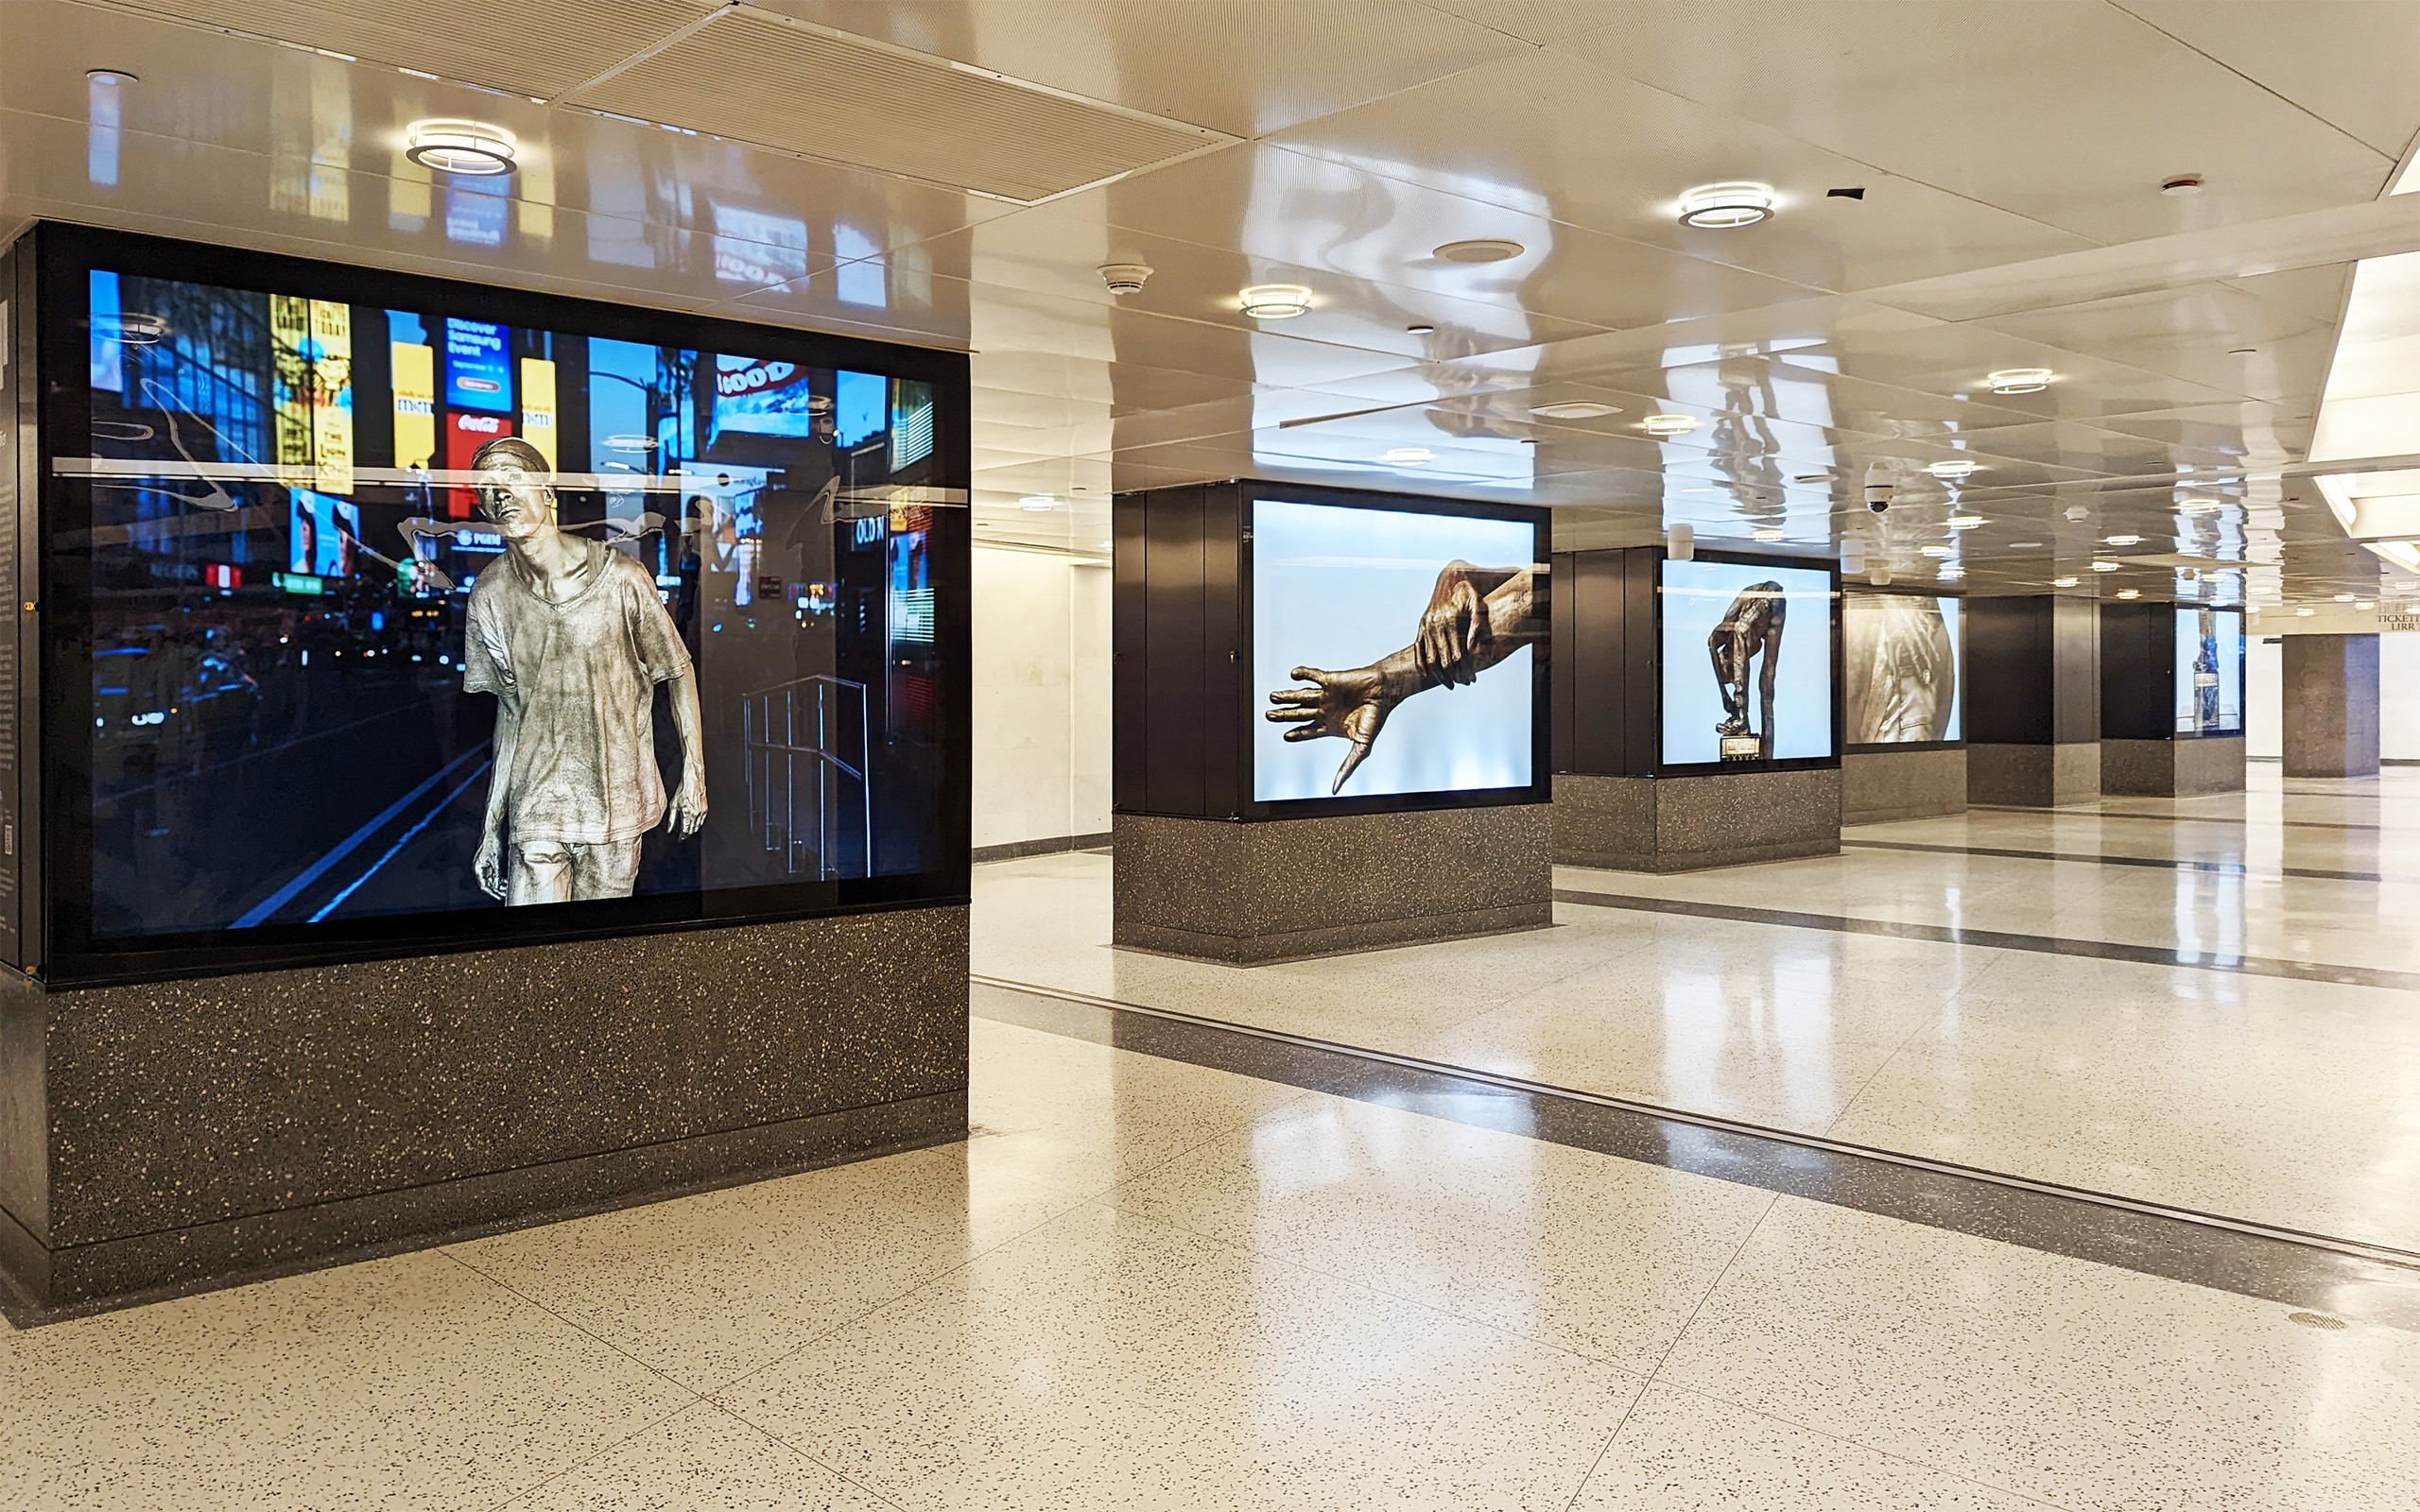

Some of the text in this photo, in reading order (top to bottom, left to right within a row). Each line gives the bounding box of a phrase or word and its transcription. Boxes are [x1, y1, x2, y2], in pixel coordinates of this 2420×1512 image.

[448, 330, 502, 351] Samsung
[448, 341, 481, 357] Event
[2391, 623, 2414, 631] LIRR
